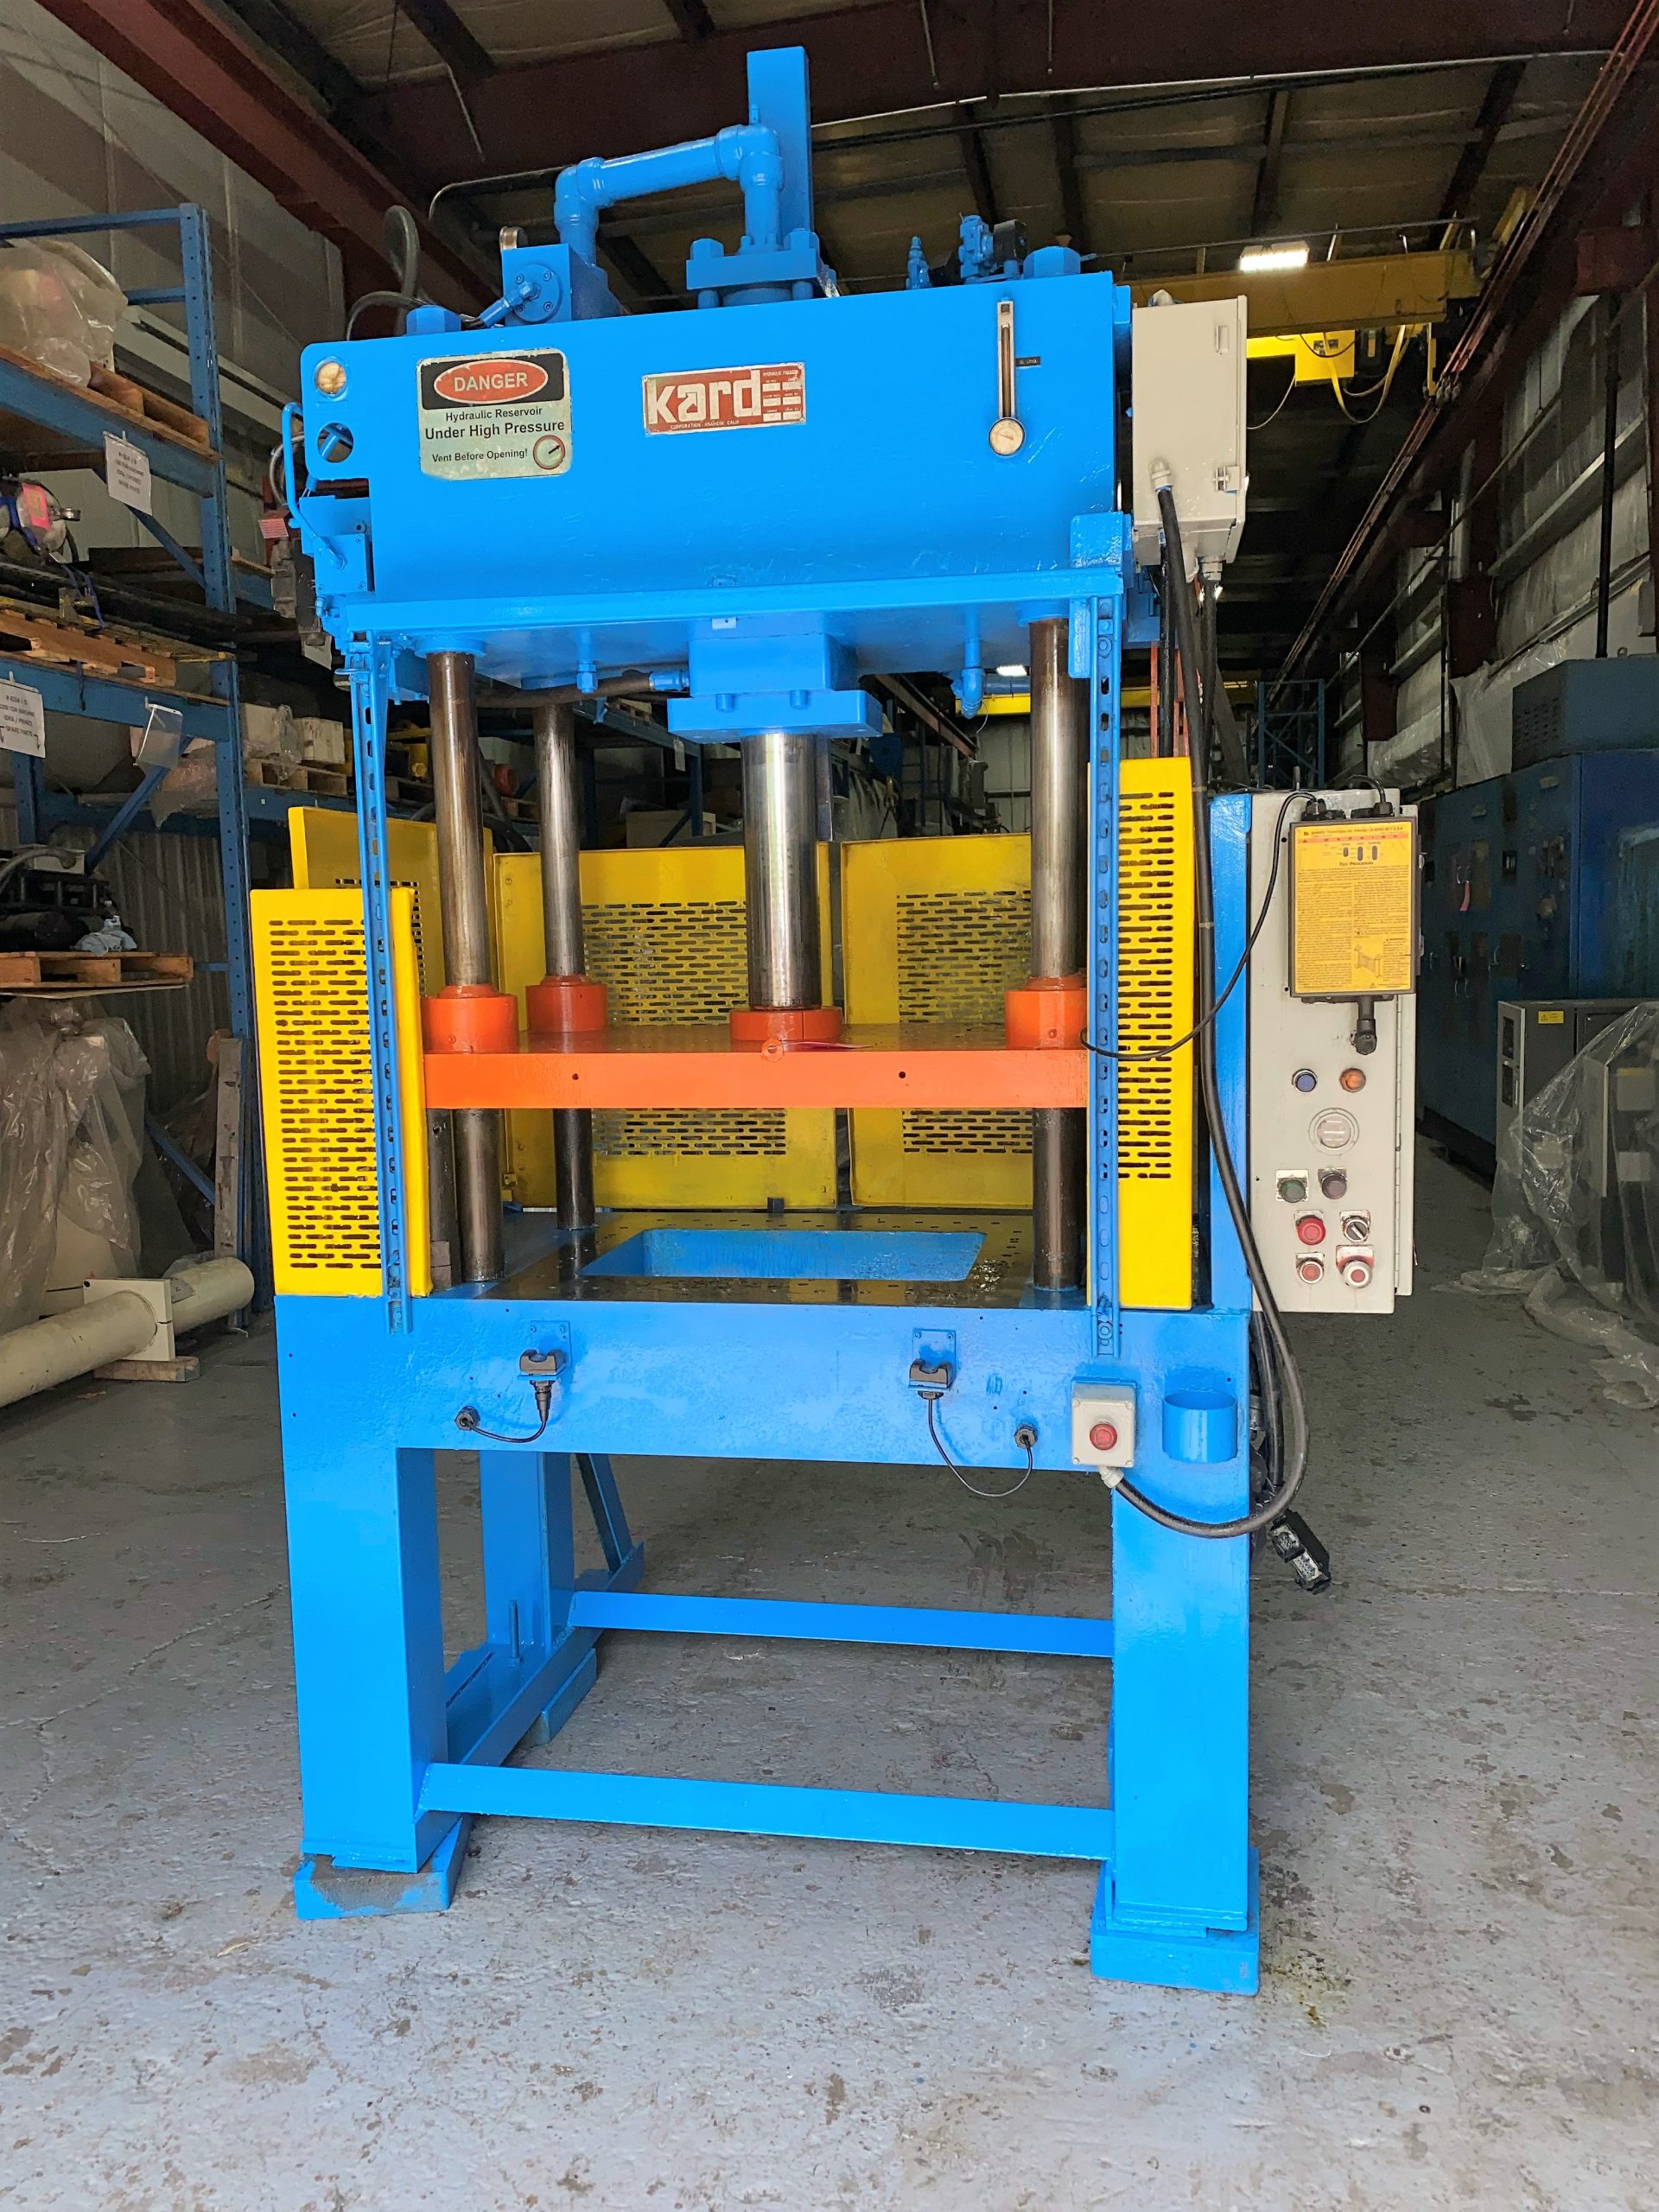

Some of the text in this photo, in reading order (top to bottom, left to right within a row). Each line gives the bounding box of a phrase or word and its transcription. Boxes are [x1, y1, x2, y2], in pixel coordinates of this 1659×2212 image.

[454, 372, 529, 392] DANGER
[647, 369, 761, 424] kard
[446, 407, 543, 423] Hydraulic Reservoir
[425, 421, 564, 440] Under High Pressure
[432, 448, 528, 462] Vent Before Opening!
